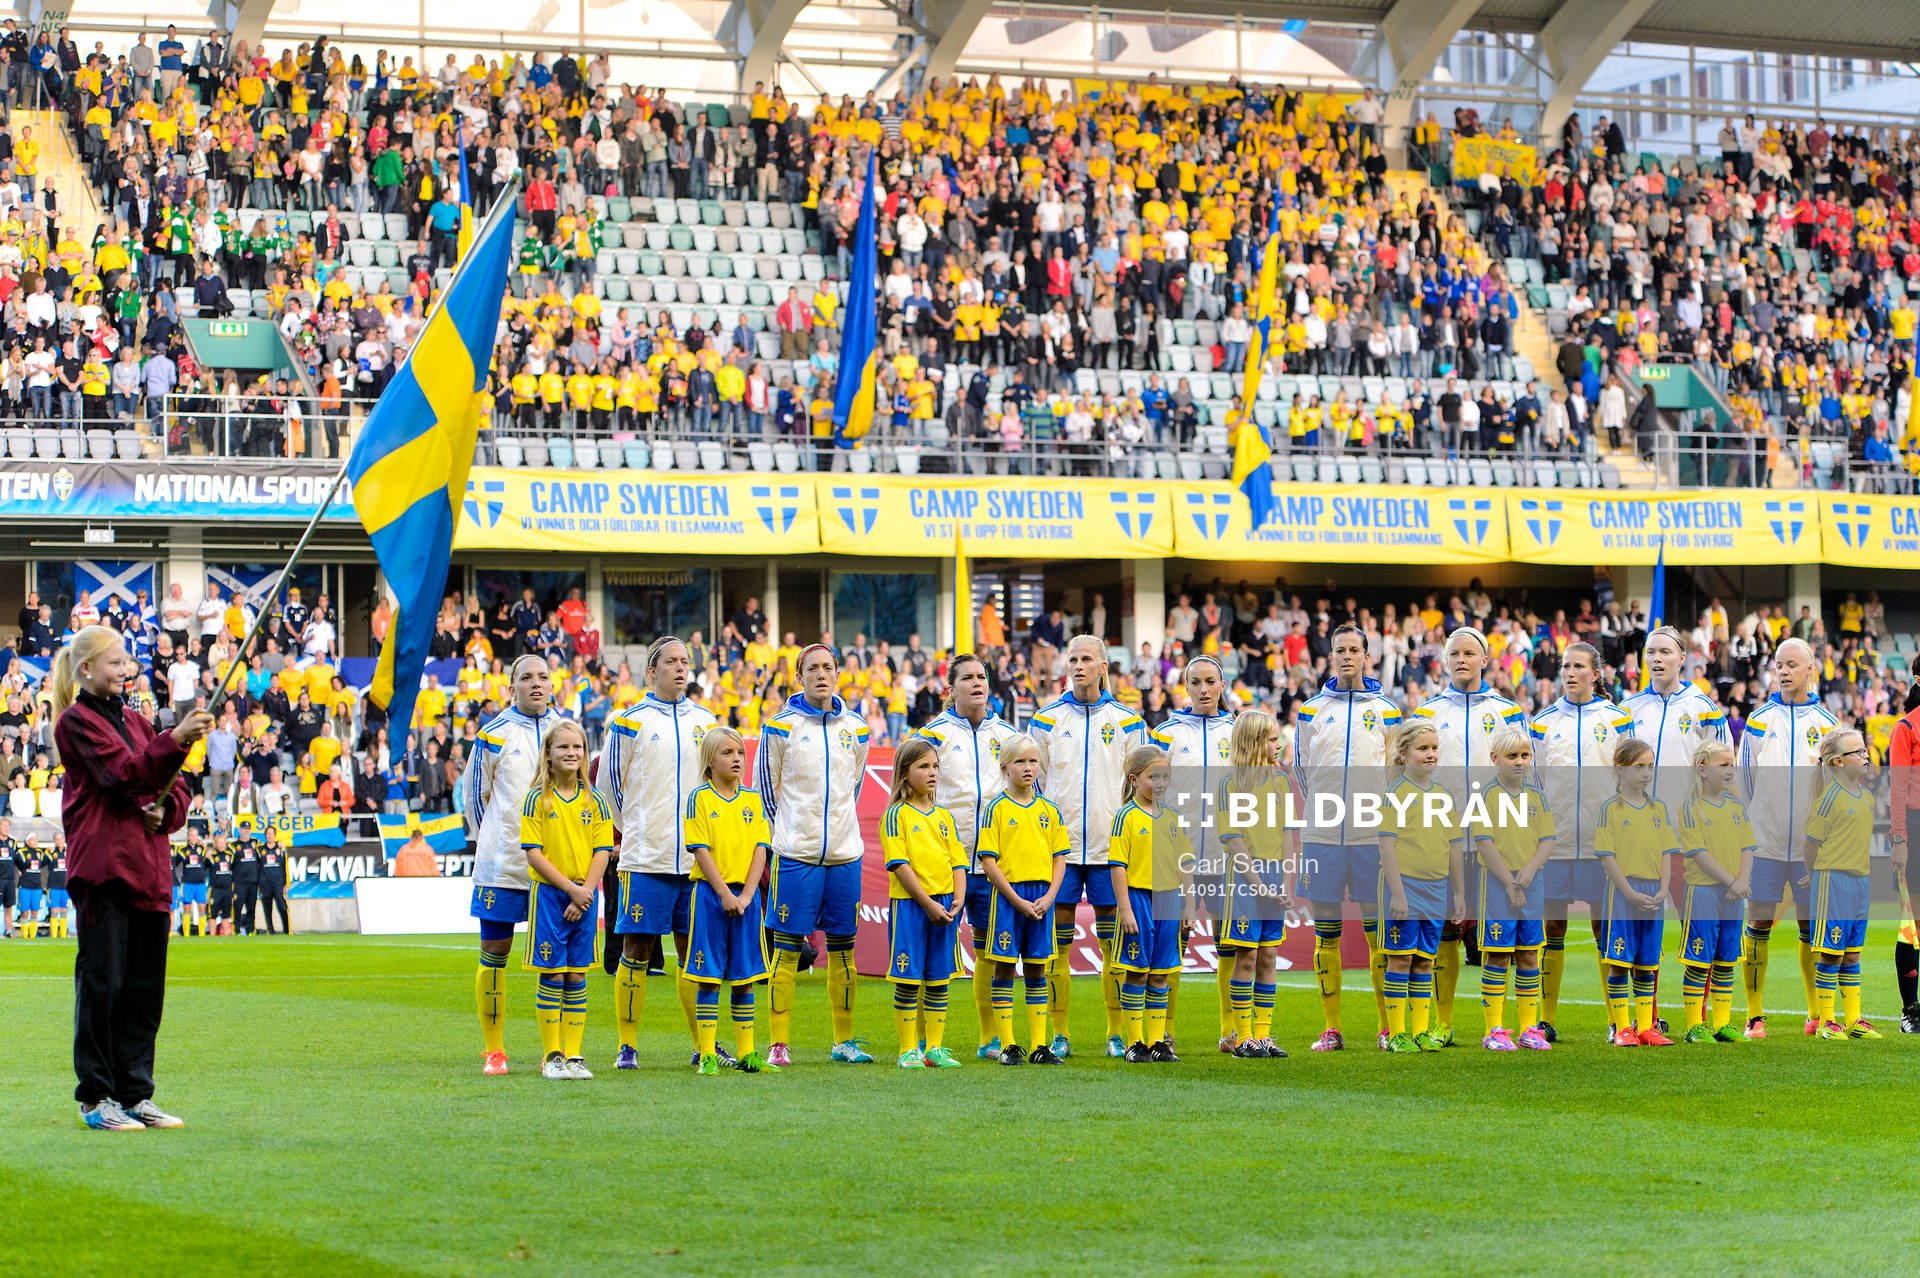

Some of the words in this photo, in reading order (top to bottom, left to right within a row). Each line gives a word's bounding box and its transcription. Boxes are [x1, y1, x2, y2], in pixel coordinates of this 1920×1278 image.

[0, 472, 49, 500] TEN
[134, 473, 355, 505] NATIONALSPORT
[529, 482, 610, 514] CAMP
[618, 483, 729, 516] SWEDEN
[909, 488, 979, 518] CAMP
[987, 490, 1084, 519] SWEDEN
[1271, 495, 1325, 526] AMP
[1332, 496, 1430, 528] SWEDEN
[1588, 500, 1651, 529] CAMP
[1657, 501, 1743, 529] SWEDEN
[520, 517, 533, 529] VI
[535, 517, 576, 531] VINNER
[579, 518, 601, 532] OCH
[923, 523, 936, 538] VI
[939, 523, 971, 538] STR
[975, 524, 998, 538] UPP
[1028, 524, 1074, 539] SVERIGE
[1890, 506, 1920, 536] CA
[1297, 530, 1316, 543] OCH
[1602, 534, 1613, 548] VI
[1693, 534, 1734, 548] SVERIGE
